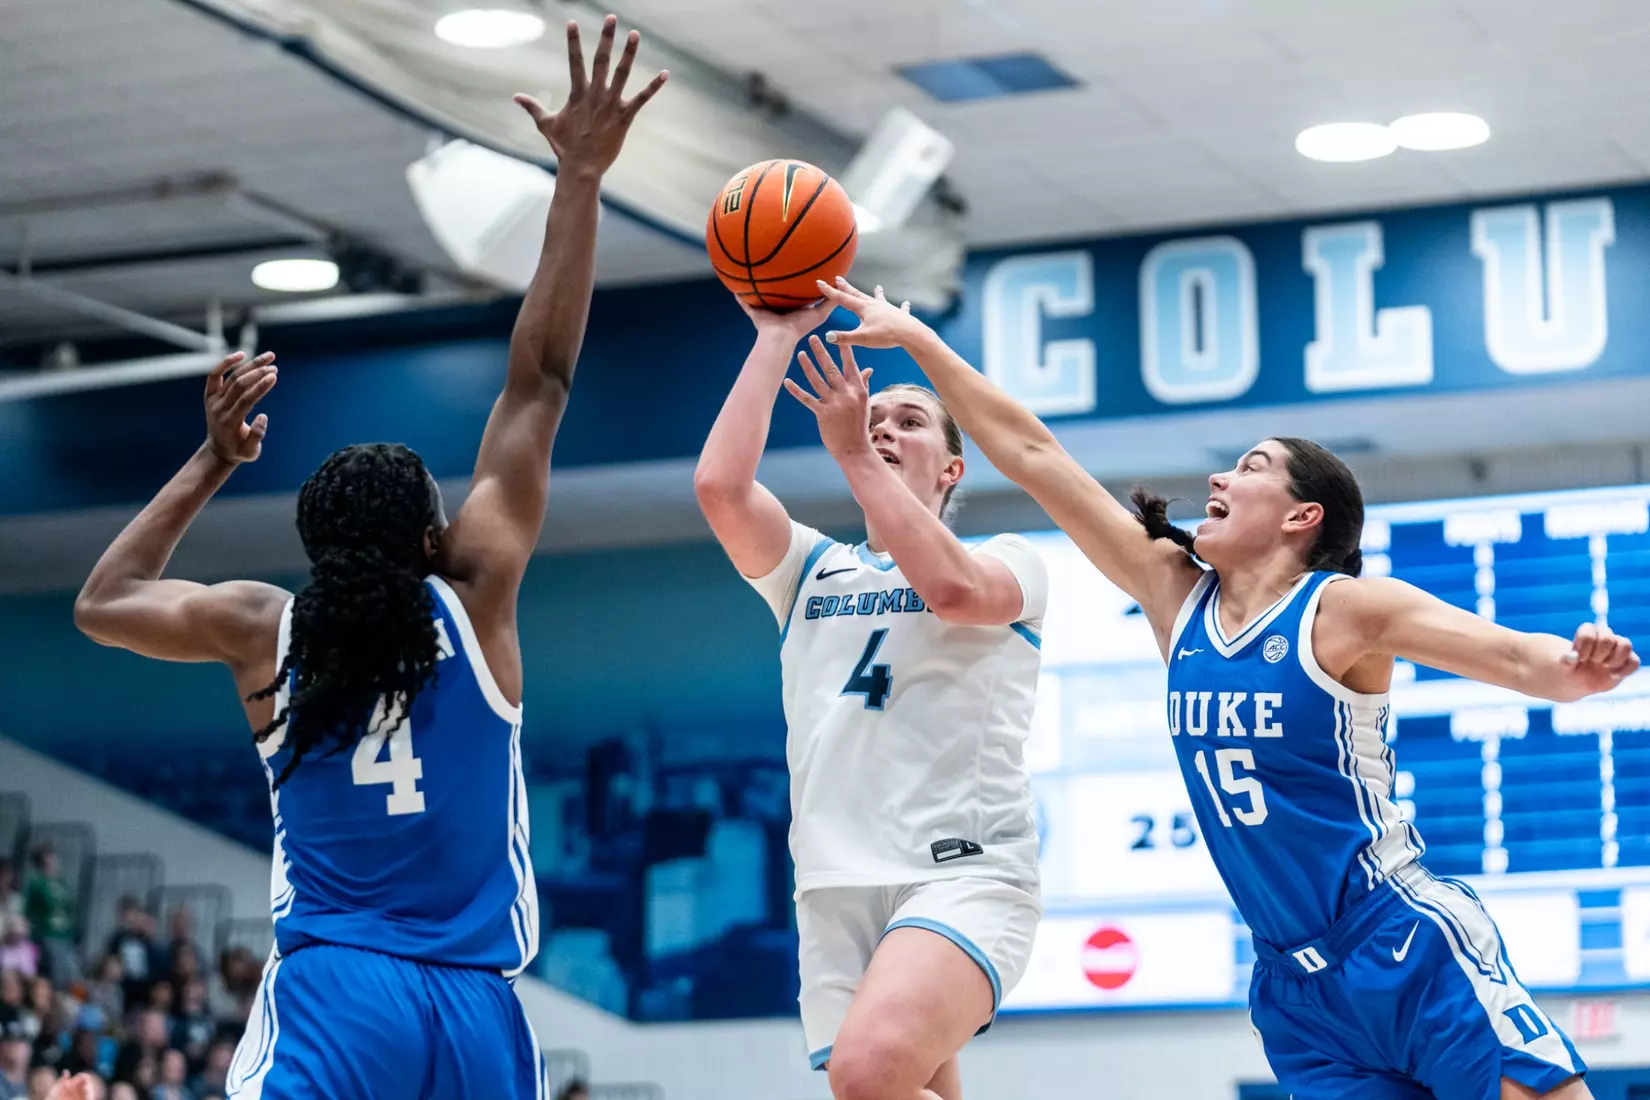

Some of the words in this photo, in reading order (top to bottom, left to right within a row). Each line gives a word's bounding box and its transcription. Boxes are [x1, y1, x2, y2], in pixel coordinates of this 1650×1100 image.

[982, 197, 1616, 417] COLU
[805, 587, 932, 620] COLUMB
[838, 628, 893, 712] 4
[350, 689, 426, 816] 4
[1169, 690, 1284, 738] DUKE
[1194, 747, 1269, 828] 15
